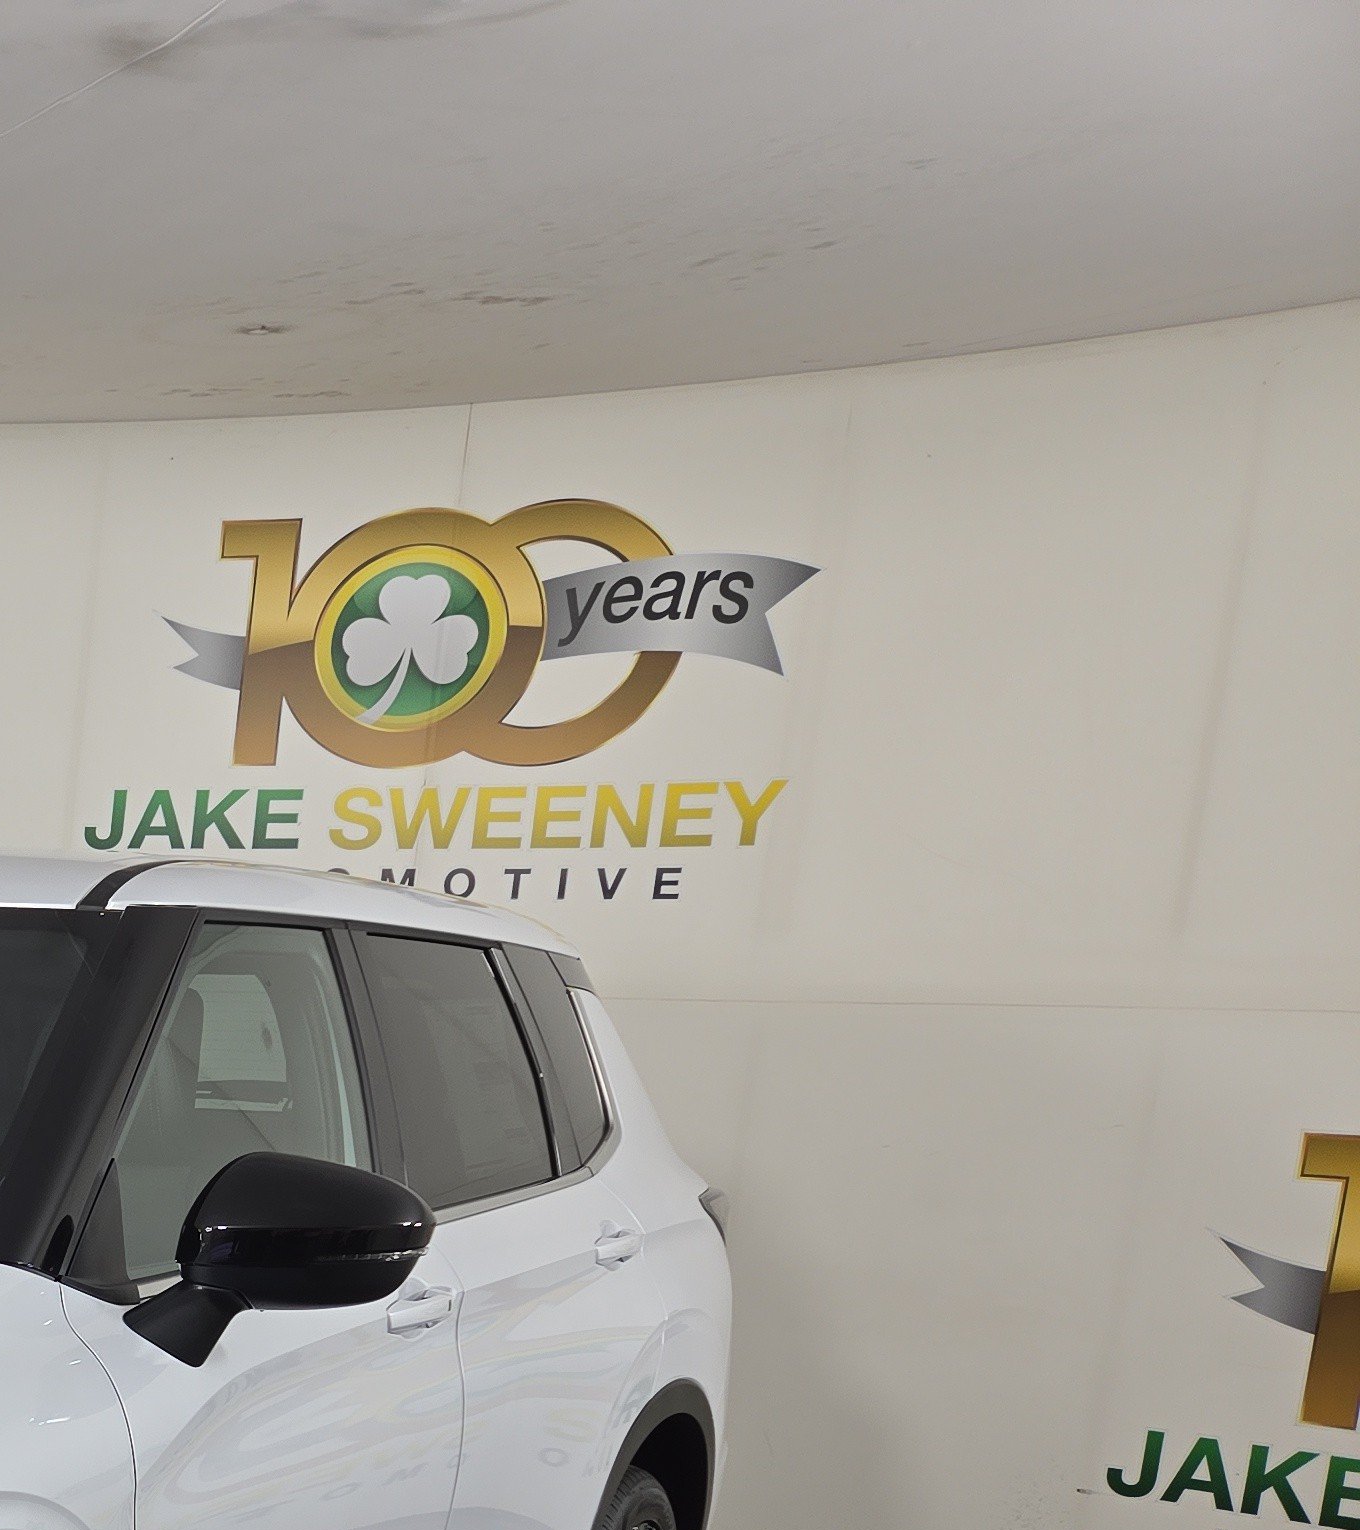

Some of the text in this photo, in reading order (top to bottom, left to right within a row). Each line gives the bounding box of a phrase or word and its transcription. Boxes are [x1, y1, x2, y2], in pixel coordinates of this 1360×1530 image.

[220, 497, 753, 768] 100 years
[83, 779, 789, 851] JAKE SWEENEY
[328, 867, 683, 901] MOTIVE
